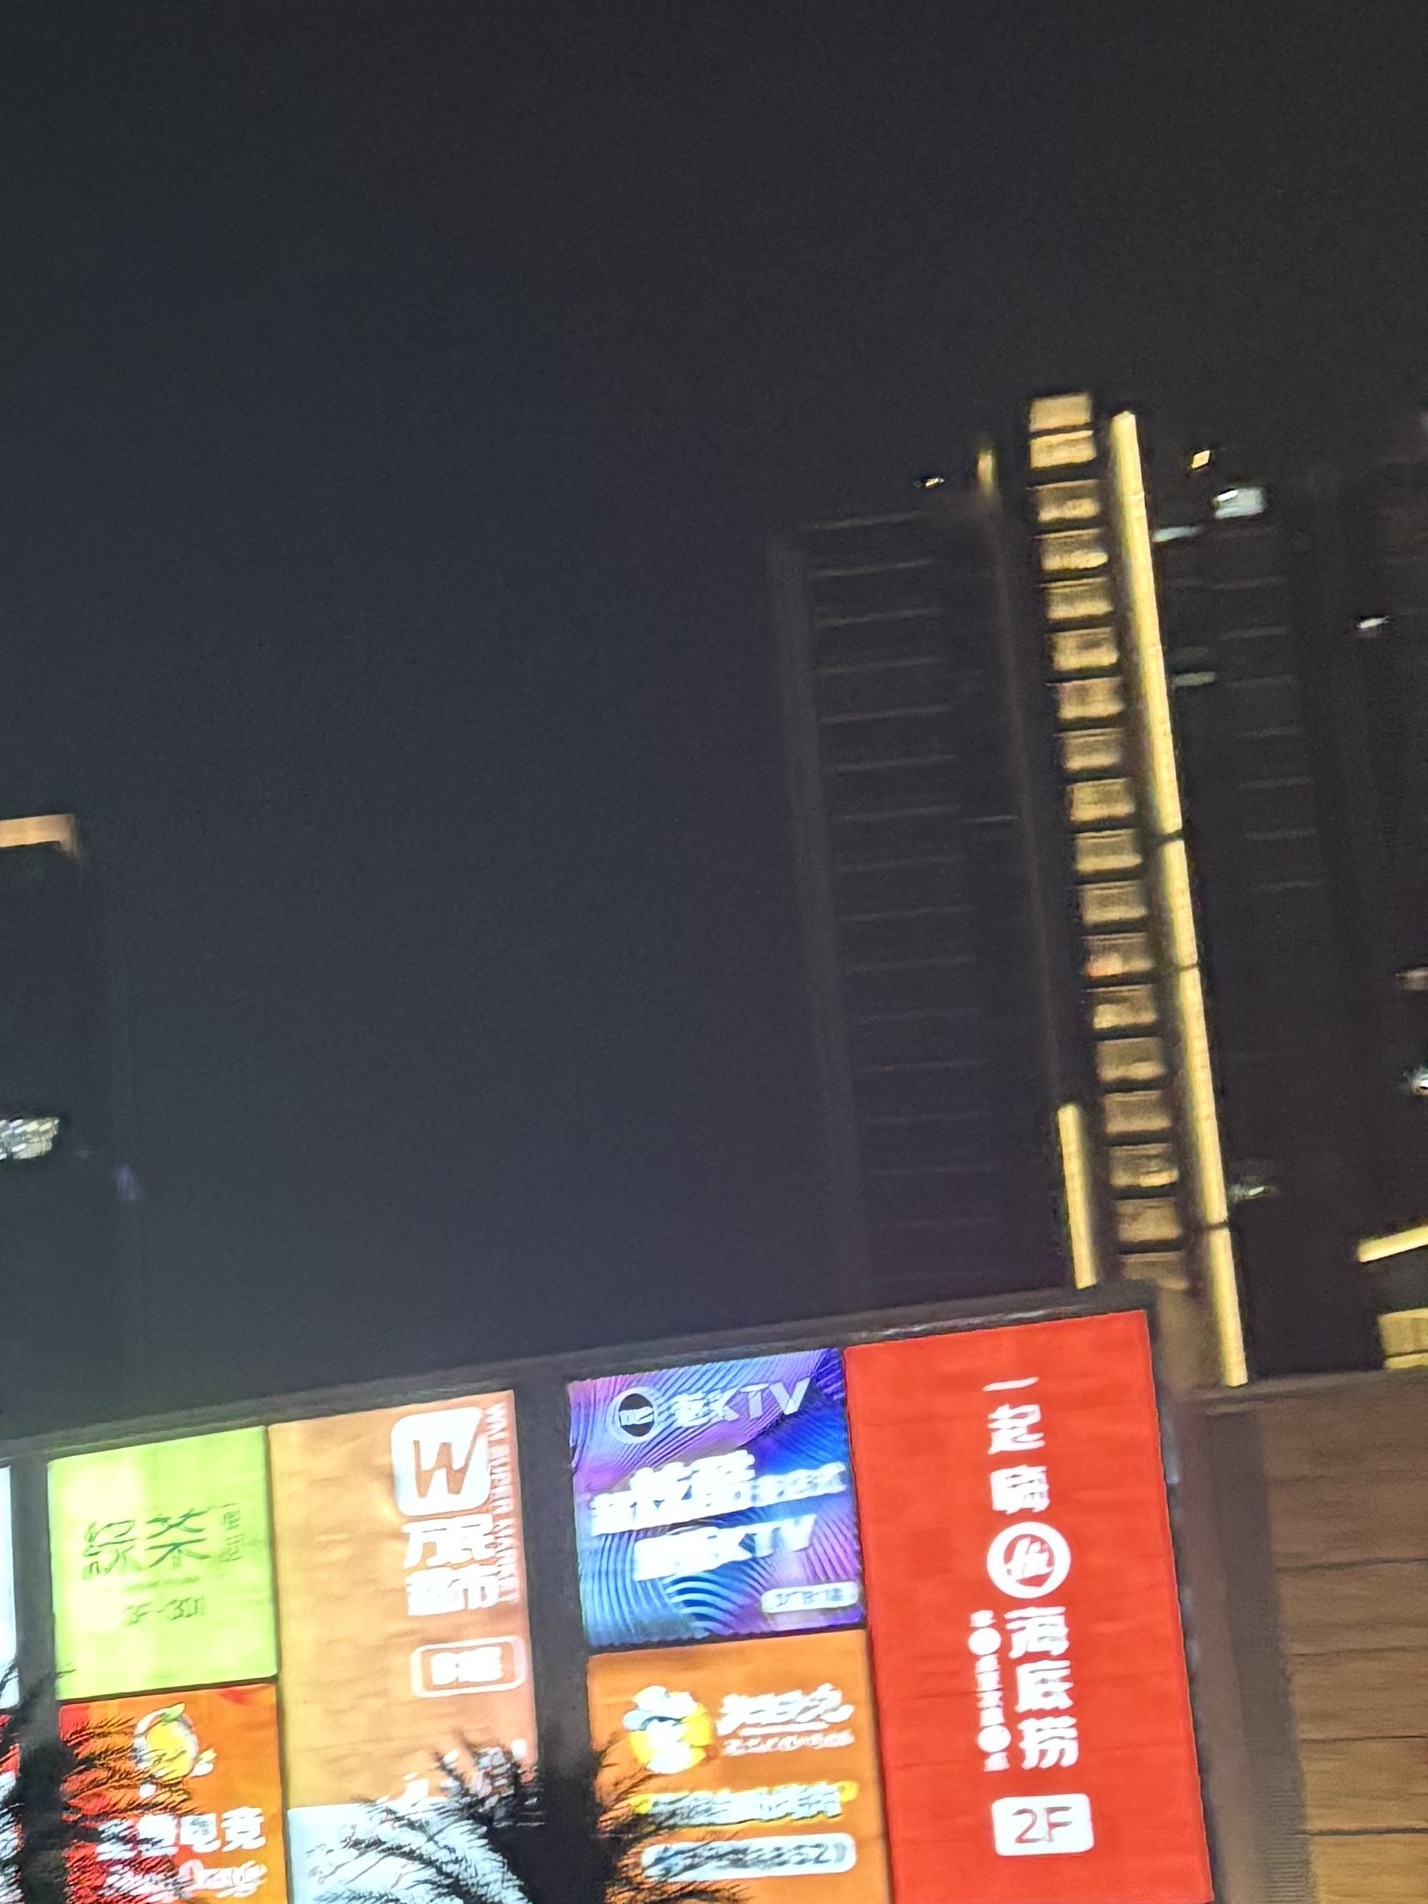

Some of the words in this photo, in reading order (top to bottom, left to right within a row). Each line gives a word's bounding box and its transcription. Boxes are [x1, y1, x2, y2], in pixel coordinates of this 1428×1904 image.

[675, 1377, 811, 1428] KTV
[1004, 1606, 1079, 1770] 海底捞
[1011, 1806, 1073, 1844] 2F
